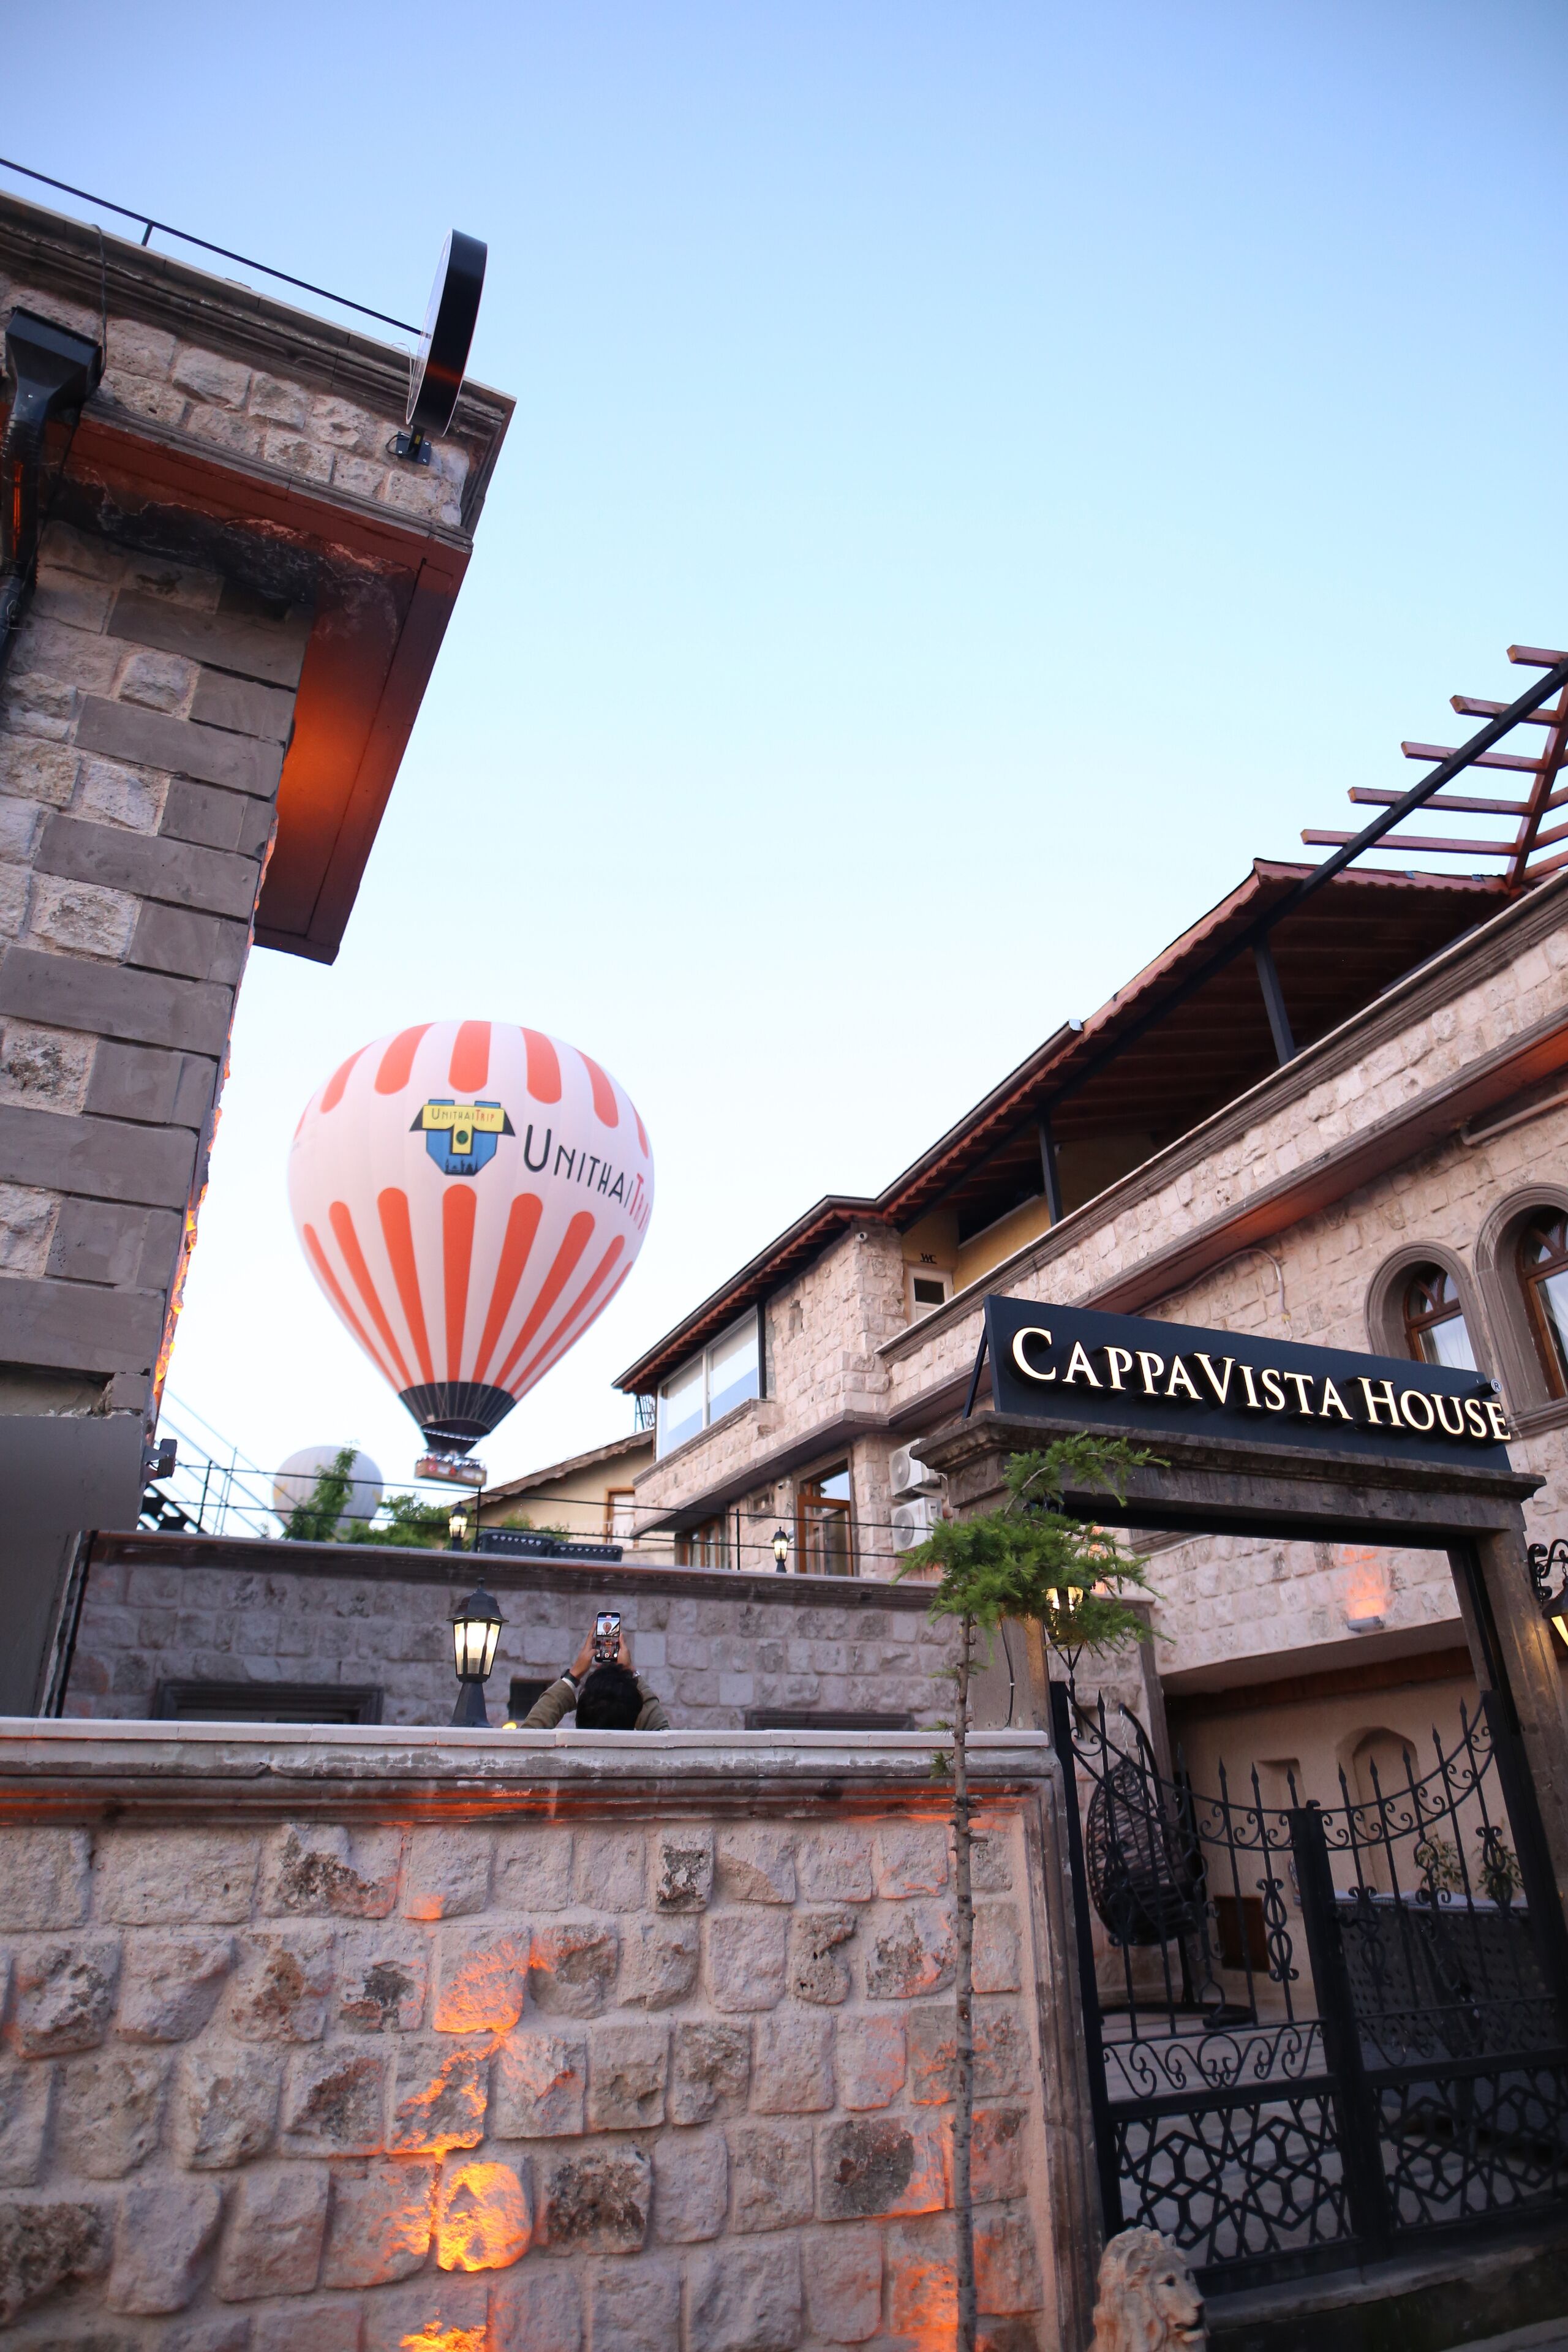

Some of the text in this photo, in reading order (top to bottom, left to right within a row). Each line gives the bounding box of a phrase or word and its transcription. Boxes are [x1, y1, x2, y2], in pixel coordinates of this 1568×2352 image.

[920, 1253, 937, 1264] WC
[1012, 1327, 1354, 1420] CAPPAVISTA
[1357, 1377, 1512, 1441] HOUSE
